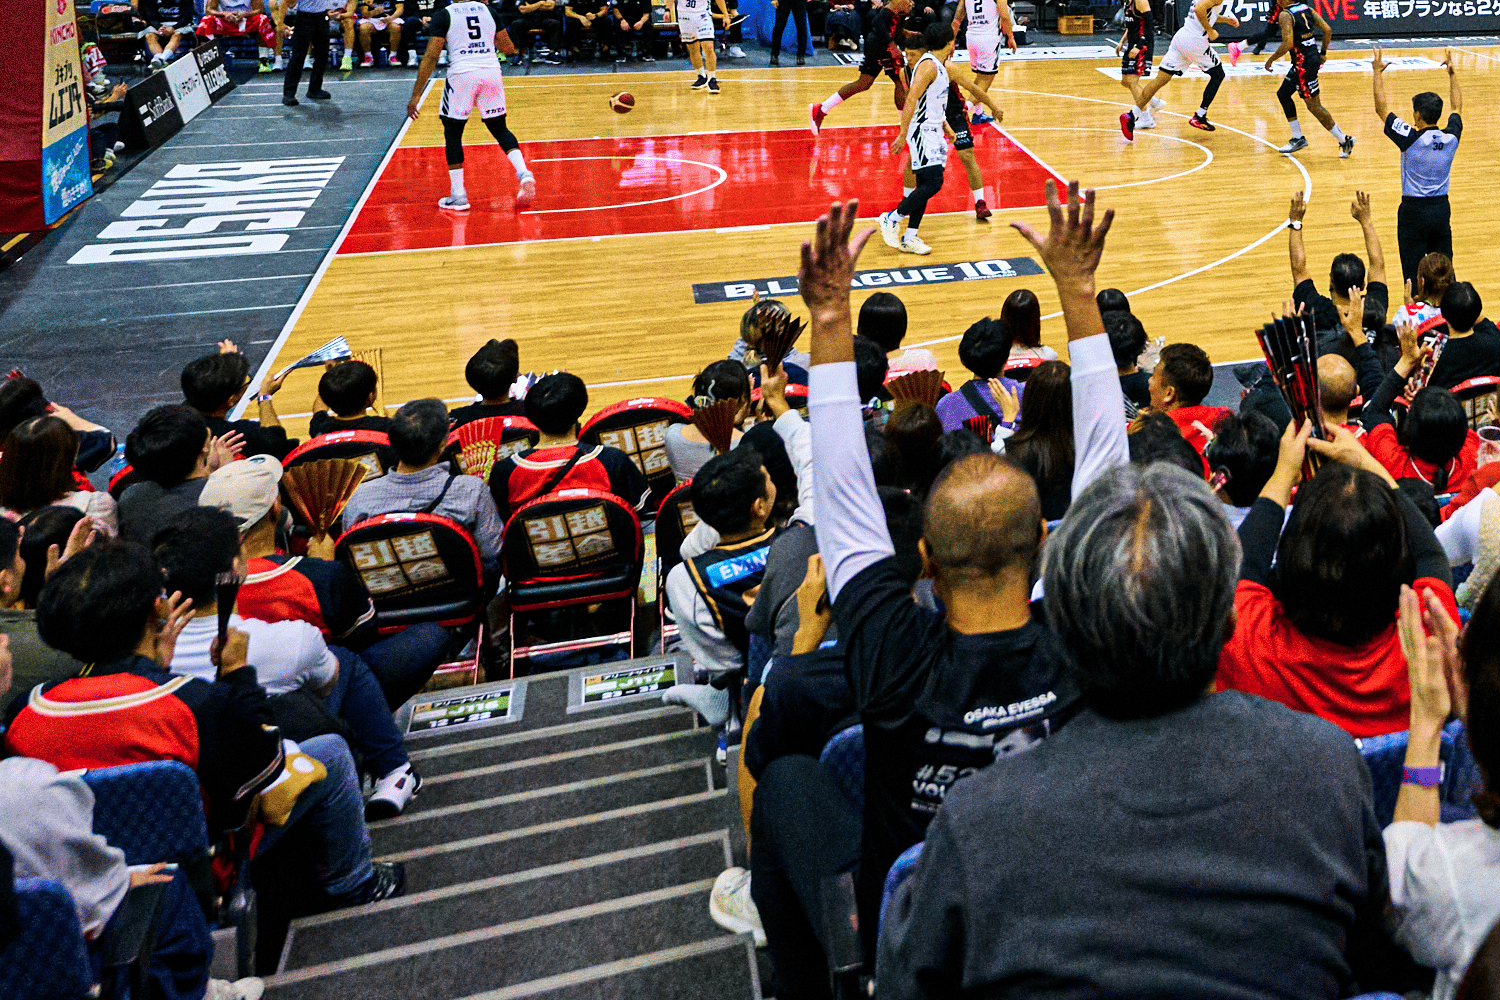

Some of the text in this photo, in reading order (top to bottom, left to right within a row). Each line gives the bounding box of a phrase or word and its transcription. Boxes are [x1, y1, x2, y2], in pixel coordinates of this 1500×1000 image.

[466, 16, 482, 40] 5
[523, 504, 608, 544] 引越
[347, 529, 436, 570] 引越
[963, 705, 1007, 725] OSAKA
[1007, 691, 1057, 714] EVESSA
